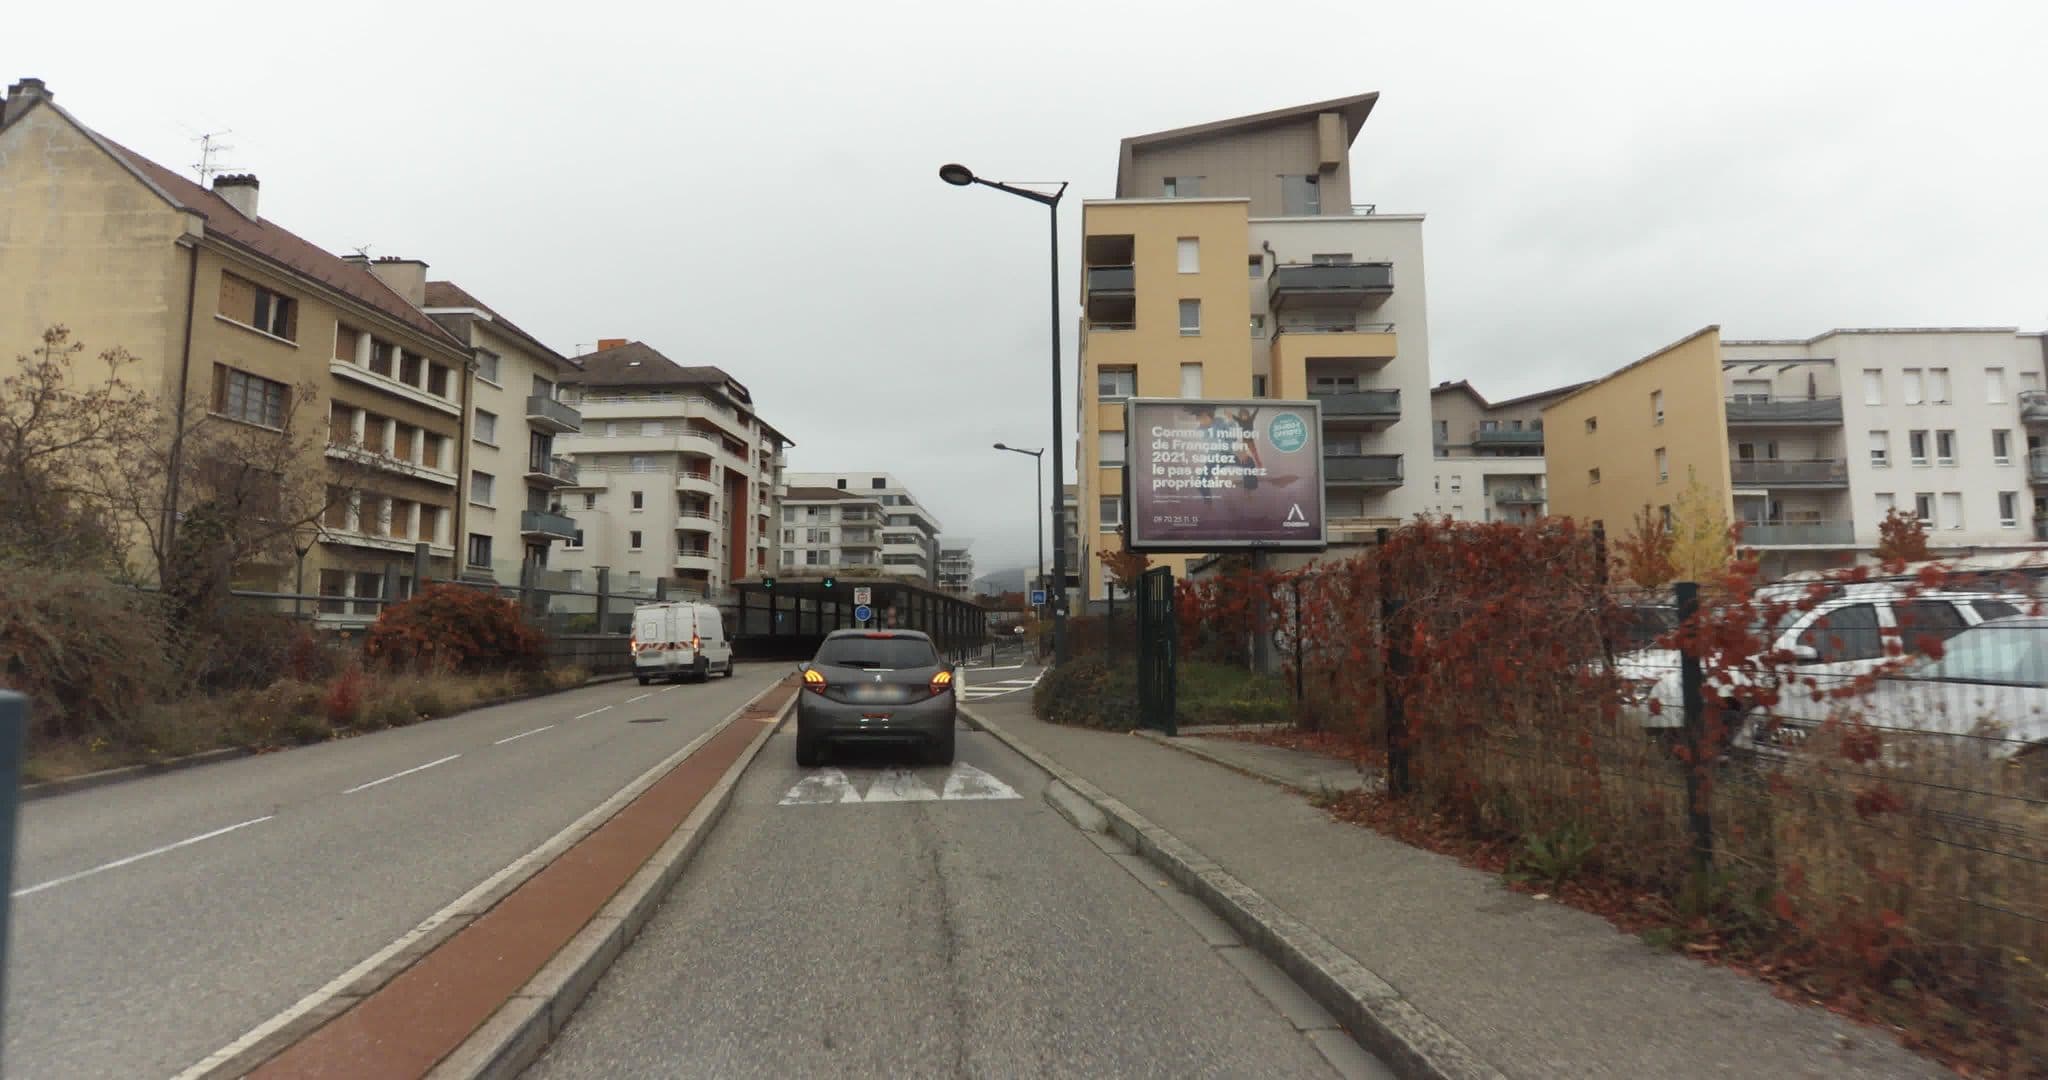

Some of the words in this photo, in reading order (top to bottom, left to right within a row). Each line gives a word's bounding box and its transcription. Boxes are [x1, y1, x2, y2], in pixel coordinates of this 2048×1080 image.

[1152, 426, 1205, 437] Comme
[1208, 427, 1214, 437] 1
[1216, 426, 1259, 438] million
[1152, 439, 1169, 450] de
[1172, 440, 1229, 451] Français
[1232, 441, 1249, 450] en
[1152, 452, 1189, 464] 2021,
[1192, 453, 1236, 463] sautez
[1152, 464, 1165, 475] le
[1168, 466, 1192, 477] pas
[1195, 466, 1208, 475] et
[1211, 464, 1267, 475] devenez
[1152, 476, 1236, 491] propriétaire.
